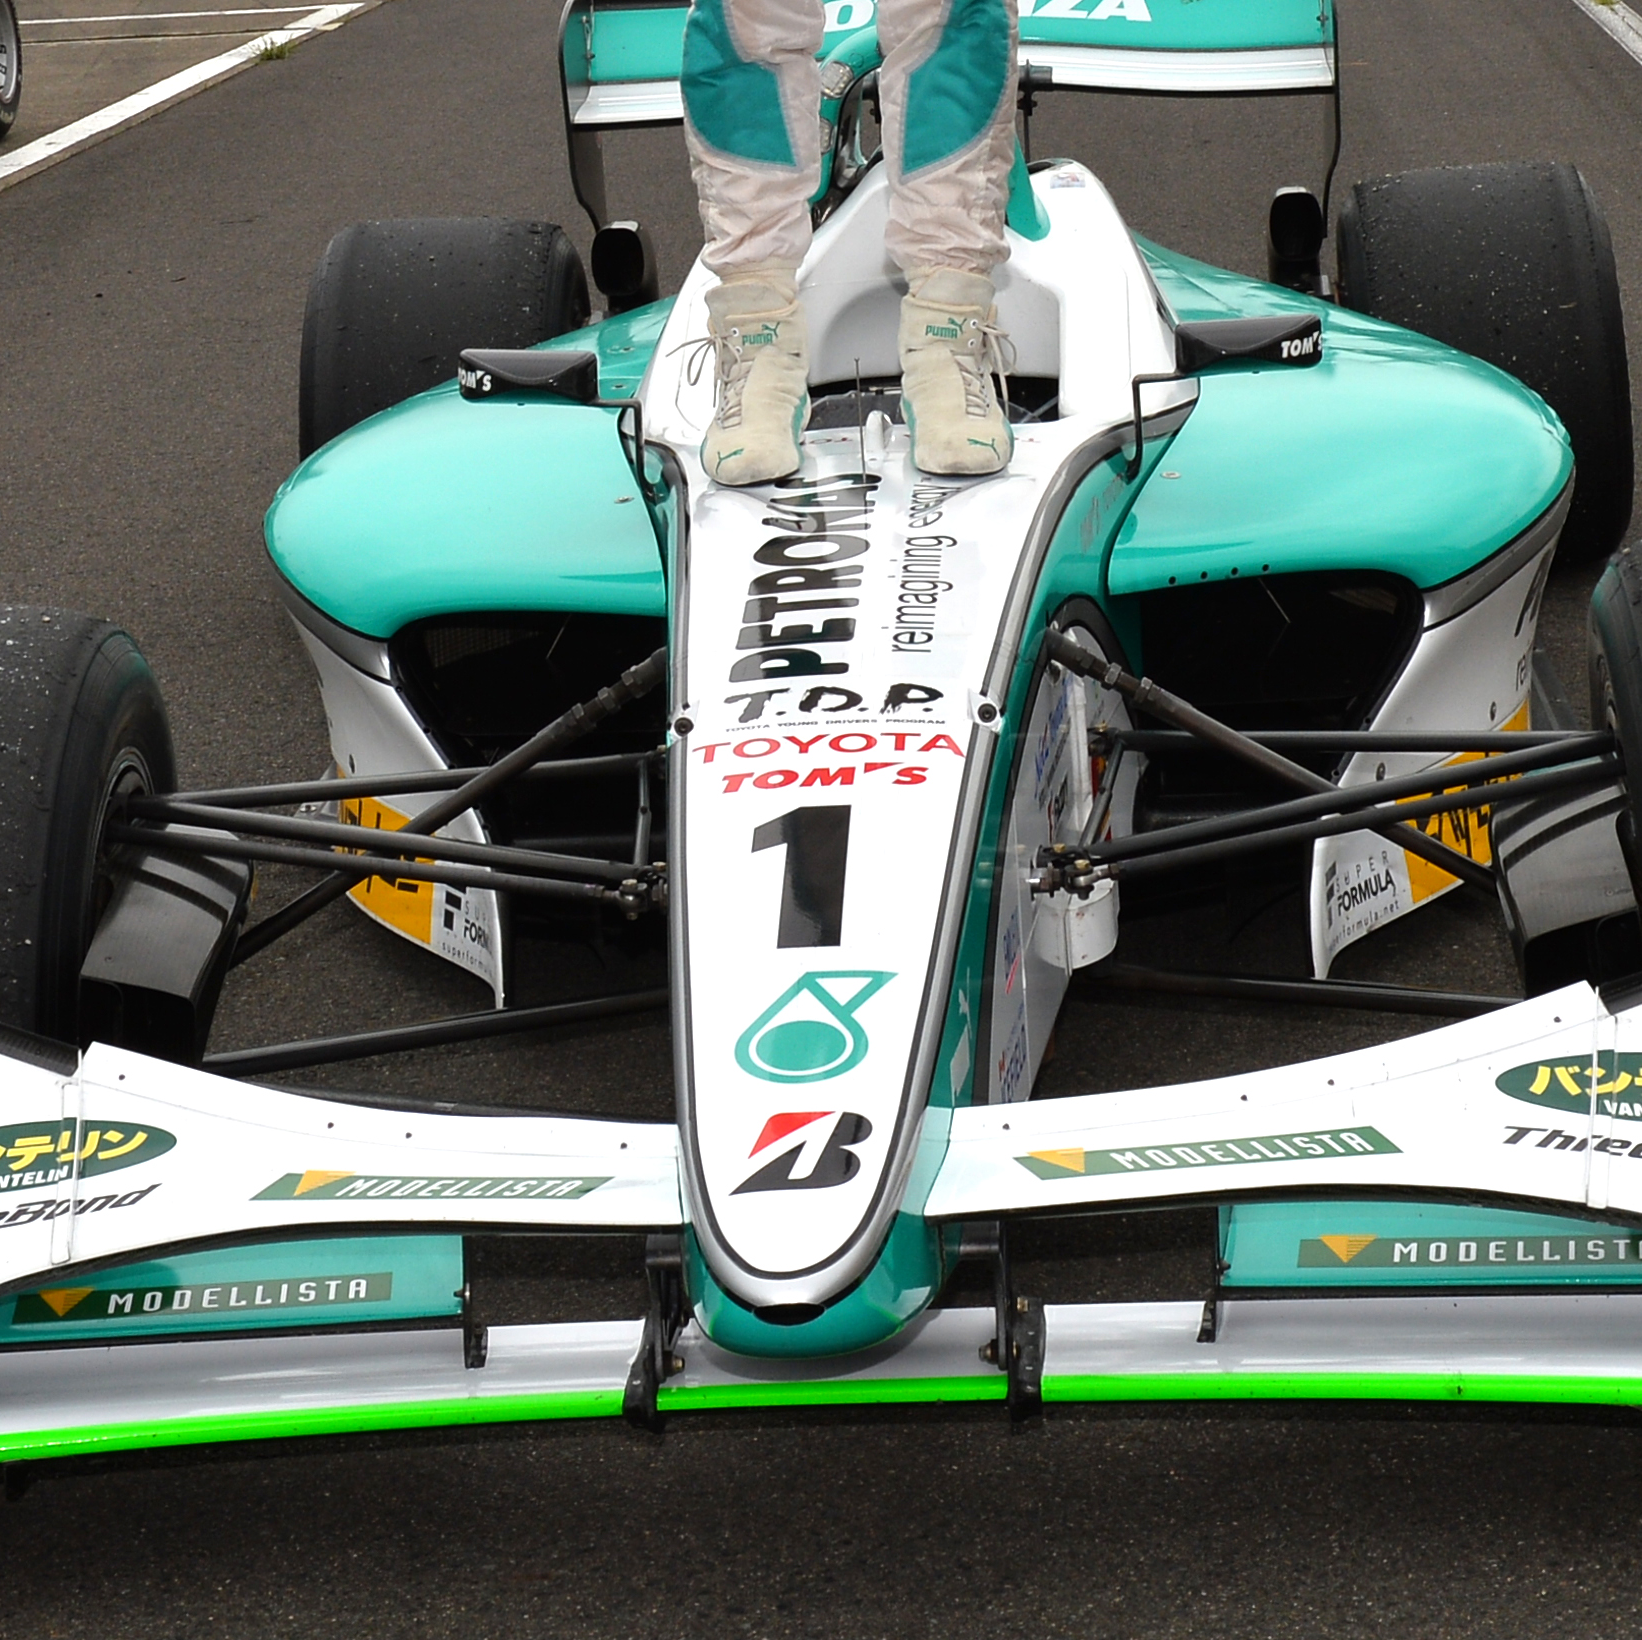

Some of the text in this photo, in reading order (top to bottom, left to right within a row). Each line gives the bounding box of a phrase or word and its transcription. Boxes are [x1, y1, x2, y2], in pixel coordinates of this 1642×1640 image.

[741, 333, 776, 346] PUMA
[924, 323, 959, 338] PUMA
[456, 368, 492, 392] OM'S
[728, 473, 882, 683] PETRONAS
[880, 534, 957, 654] reimagining
[725, 724, 770, 733] TOYOTA
[777, 720, 819, 728] YOUNG
[692, 733, 967, 765] TOYOTA
[722, 762, 930, 794] TOM'S
[751, 804, 853, 949] 1
[1336, 867, 1396, 918] FORMULA
[1107, 1133, 1370, 1172] MODELLISTA
[340, 1175, 586, 1200] MODELLISTA
[106, 1276, 369, 1316] MODELLISTA
